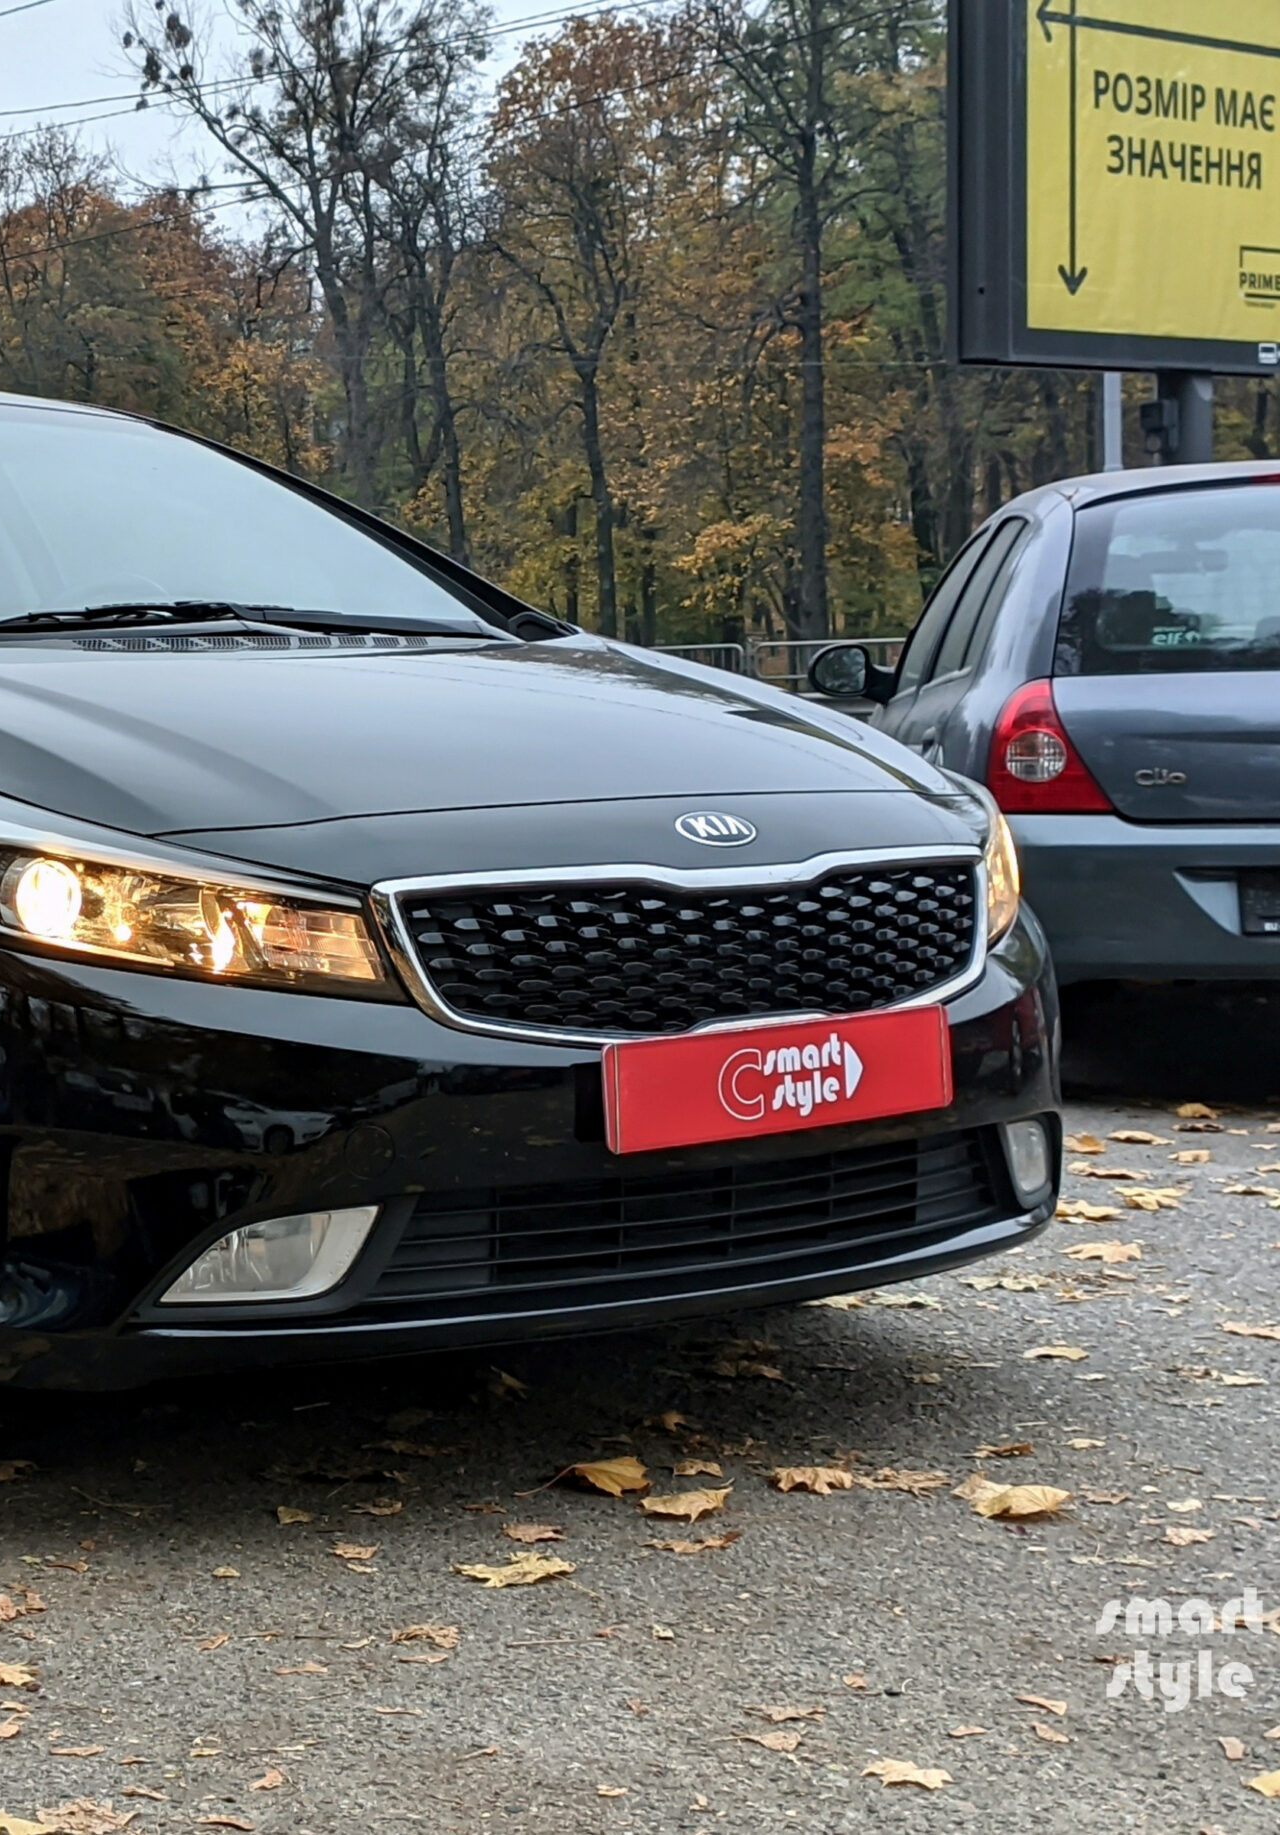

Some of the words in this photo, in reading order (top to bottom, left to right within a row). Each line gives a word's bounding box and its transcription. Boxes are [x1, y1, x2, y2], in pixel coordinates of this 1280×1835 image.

[1093, 69, 1206, 123] РОЗМІР
[1214, 87, 1276, 132] МАЄ
[1106, 134, 1263, 190] ЗНАЧЕННЯ
[684, 815, 751, 838] KIA
[763, 1032, 841, 1076] smart
[772, 1070, 840, 1117] style
